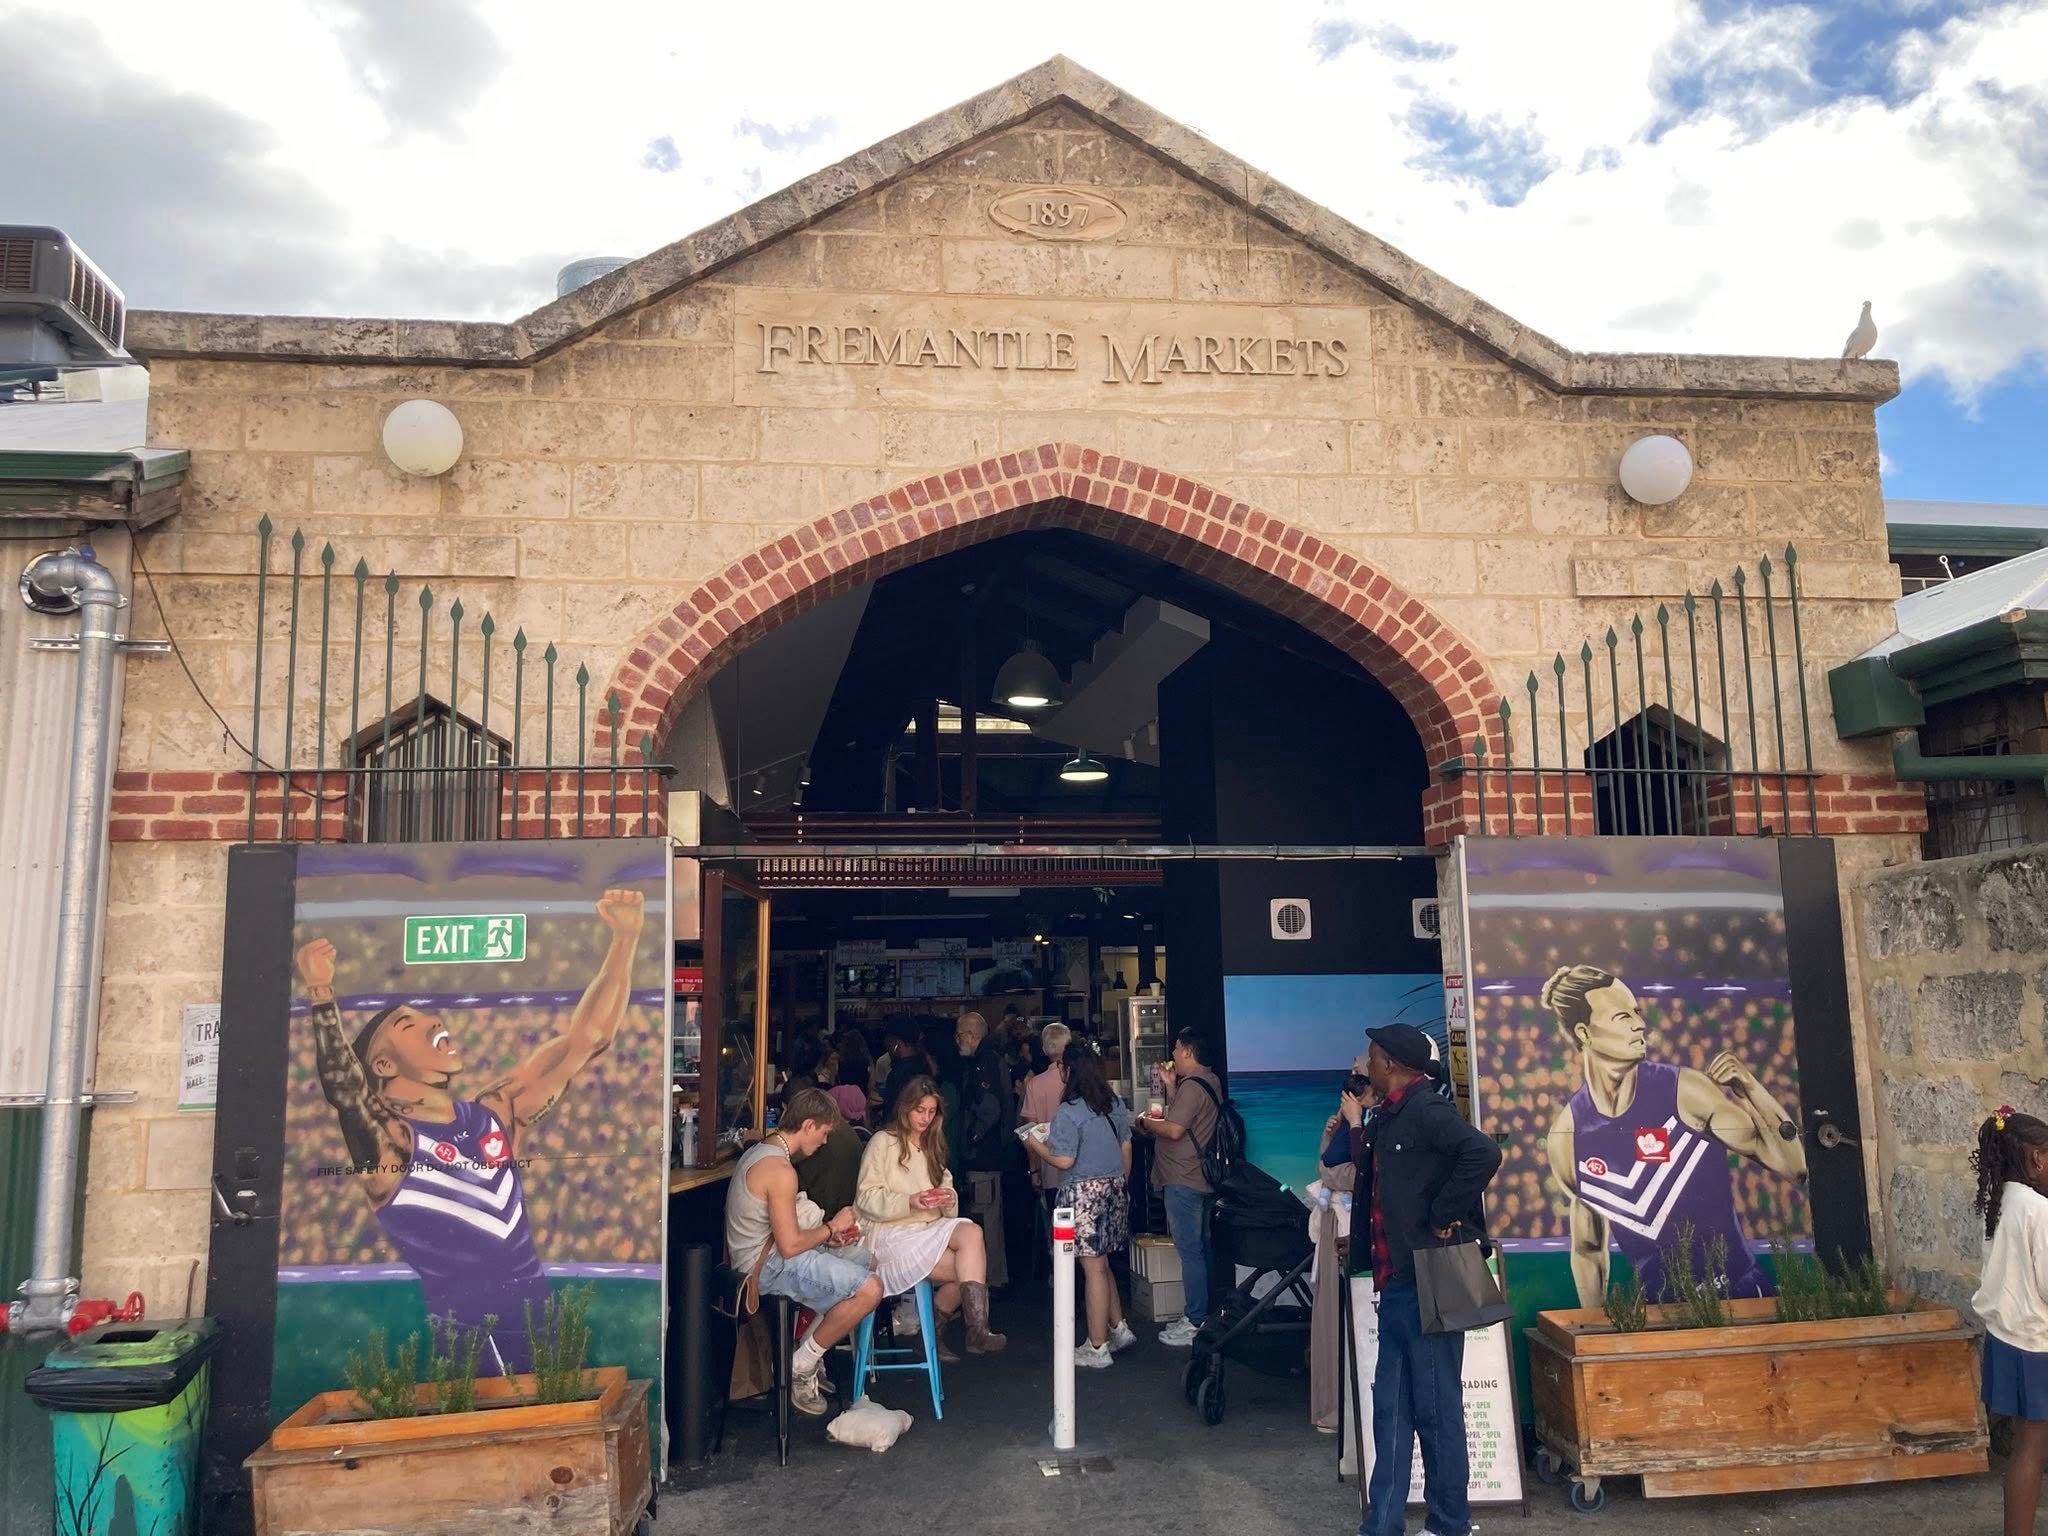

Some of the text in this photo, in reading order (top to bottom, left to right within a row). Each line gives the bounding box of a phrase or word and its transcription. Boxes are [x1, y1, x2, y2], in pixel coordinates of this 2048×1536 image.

[1027, 202, 1090, 228] 1897
[758, 324, 1350, 384] FREMANTLE MARKETS
[417, 925, 474, 954] EXIT
[437, 1145, 453, 1161] AFL
[318, 1167, 341, 1176] FIRE
[345, 1164, 387, 1175] SAFETY
[391, 1163, 424, 1174] DOOR
[472, 1159, 532, 1170] OBSTRUCT
[1587, 1159, 1605, 1174] AFL
[1482, 1451, 1496, 1459] OPEN
[1486, 1481, 1501, 1489] OPEN
